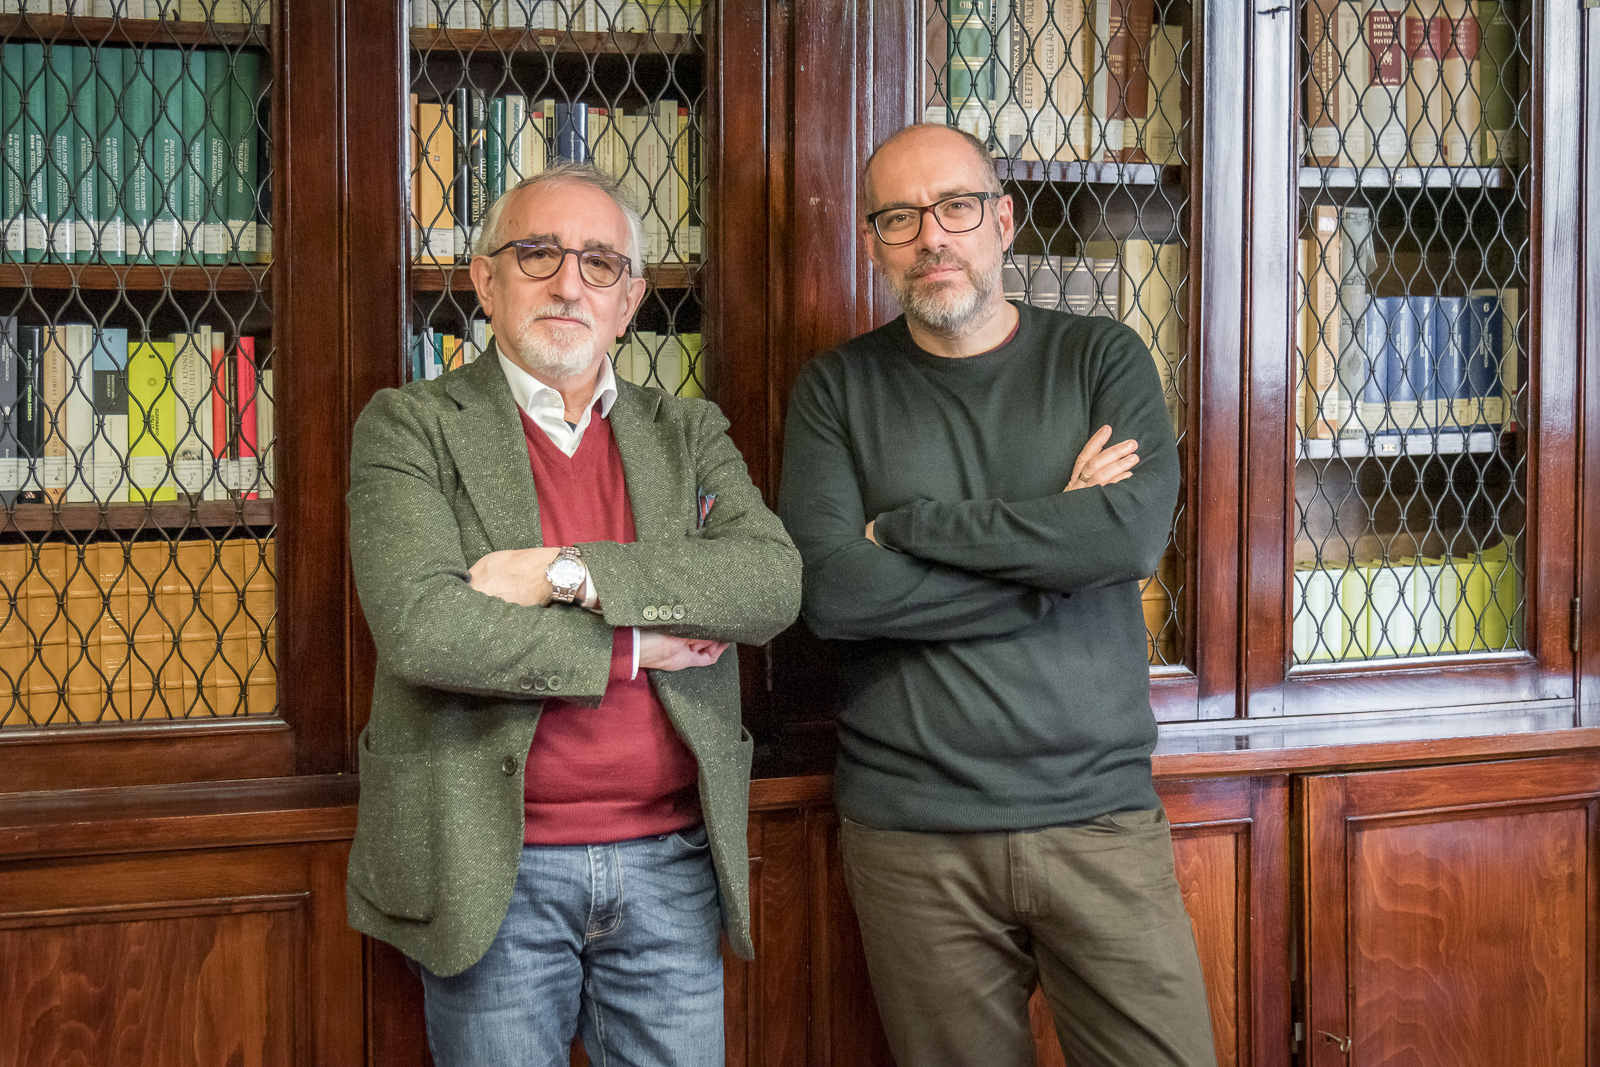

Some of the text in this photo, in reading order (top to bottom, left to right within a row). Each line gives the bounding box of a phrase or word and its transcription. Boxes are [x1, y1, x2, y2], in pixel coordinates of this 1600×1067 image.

[1046, 44, 1054, 70] DEGLI
[1423, 304, 1429, 313] 3
[1452, 304, 1458, 314] 4
[1483, 303, 1490, 312] 6
